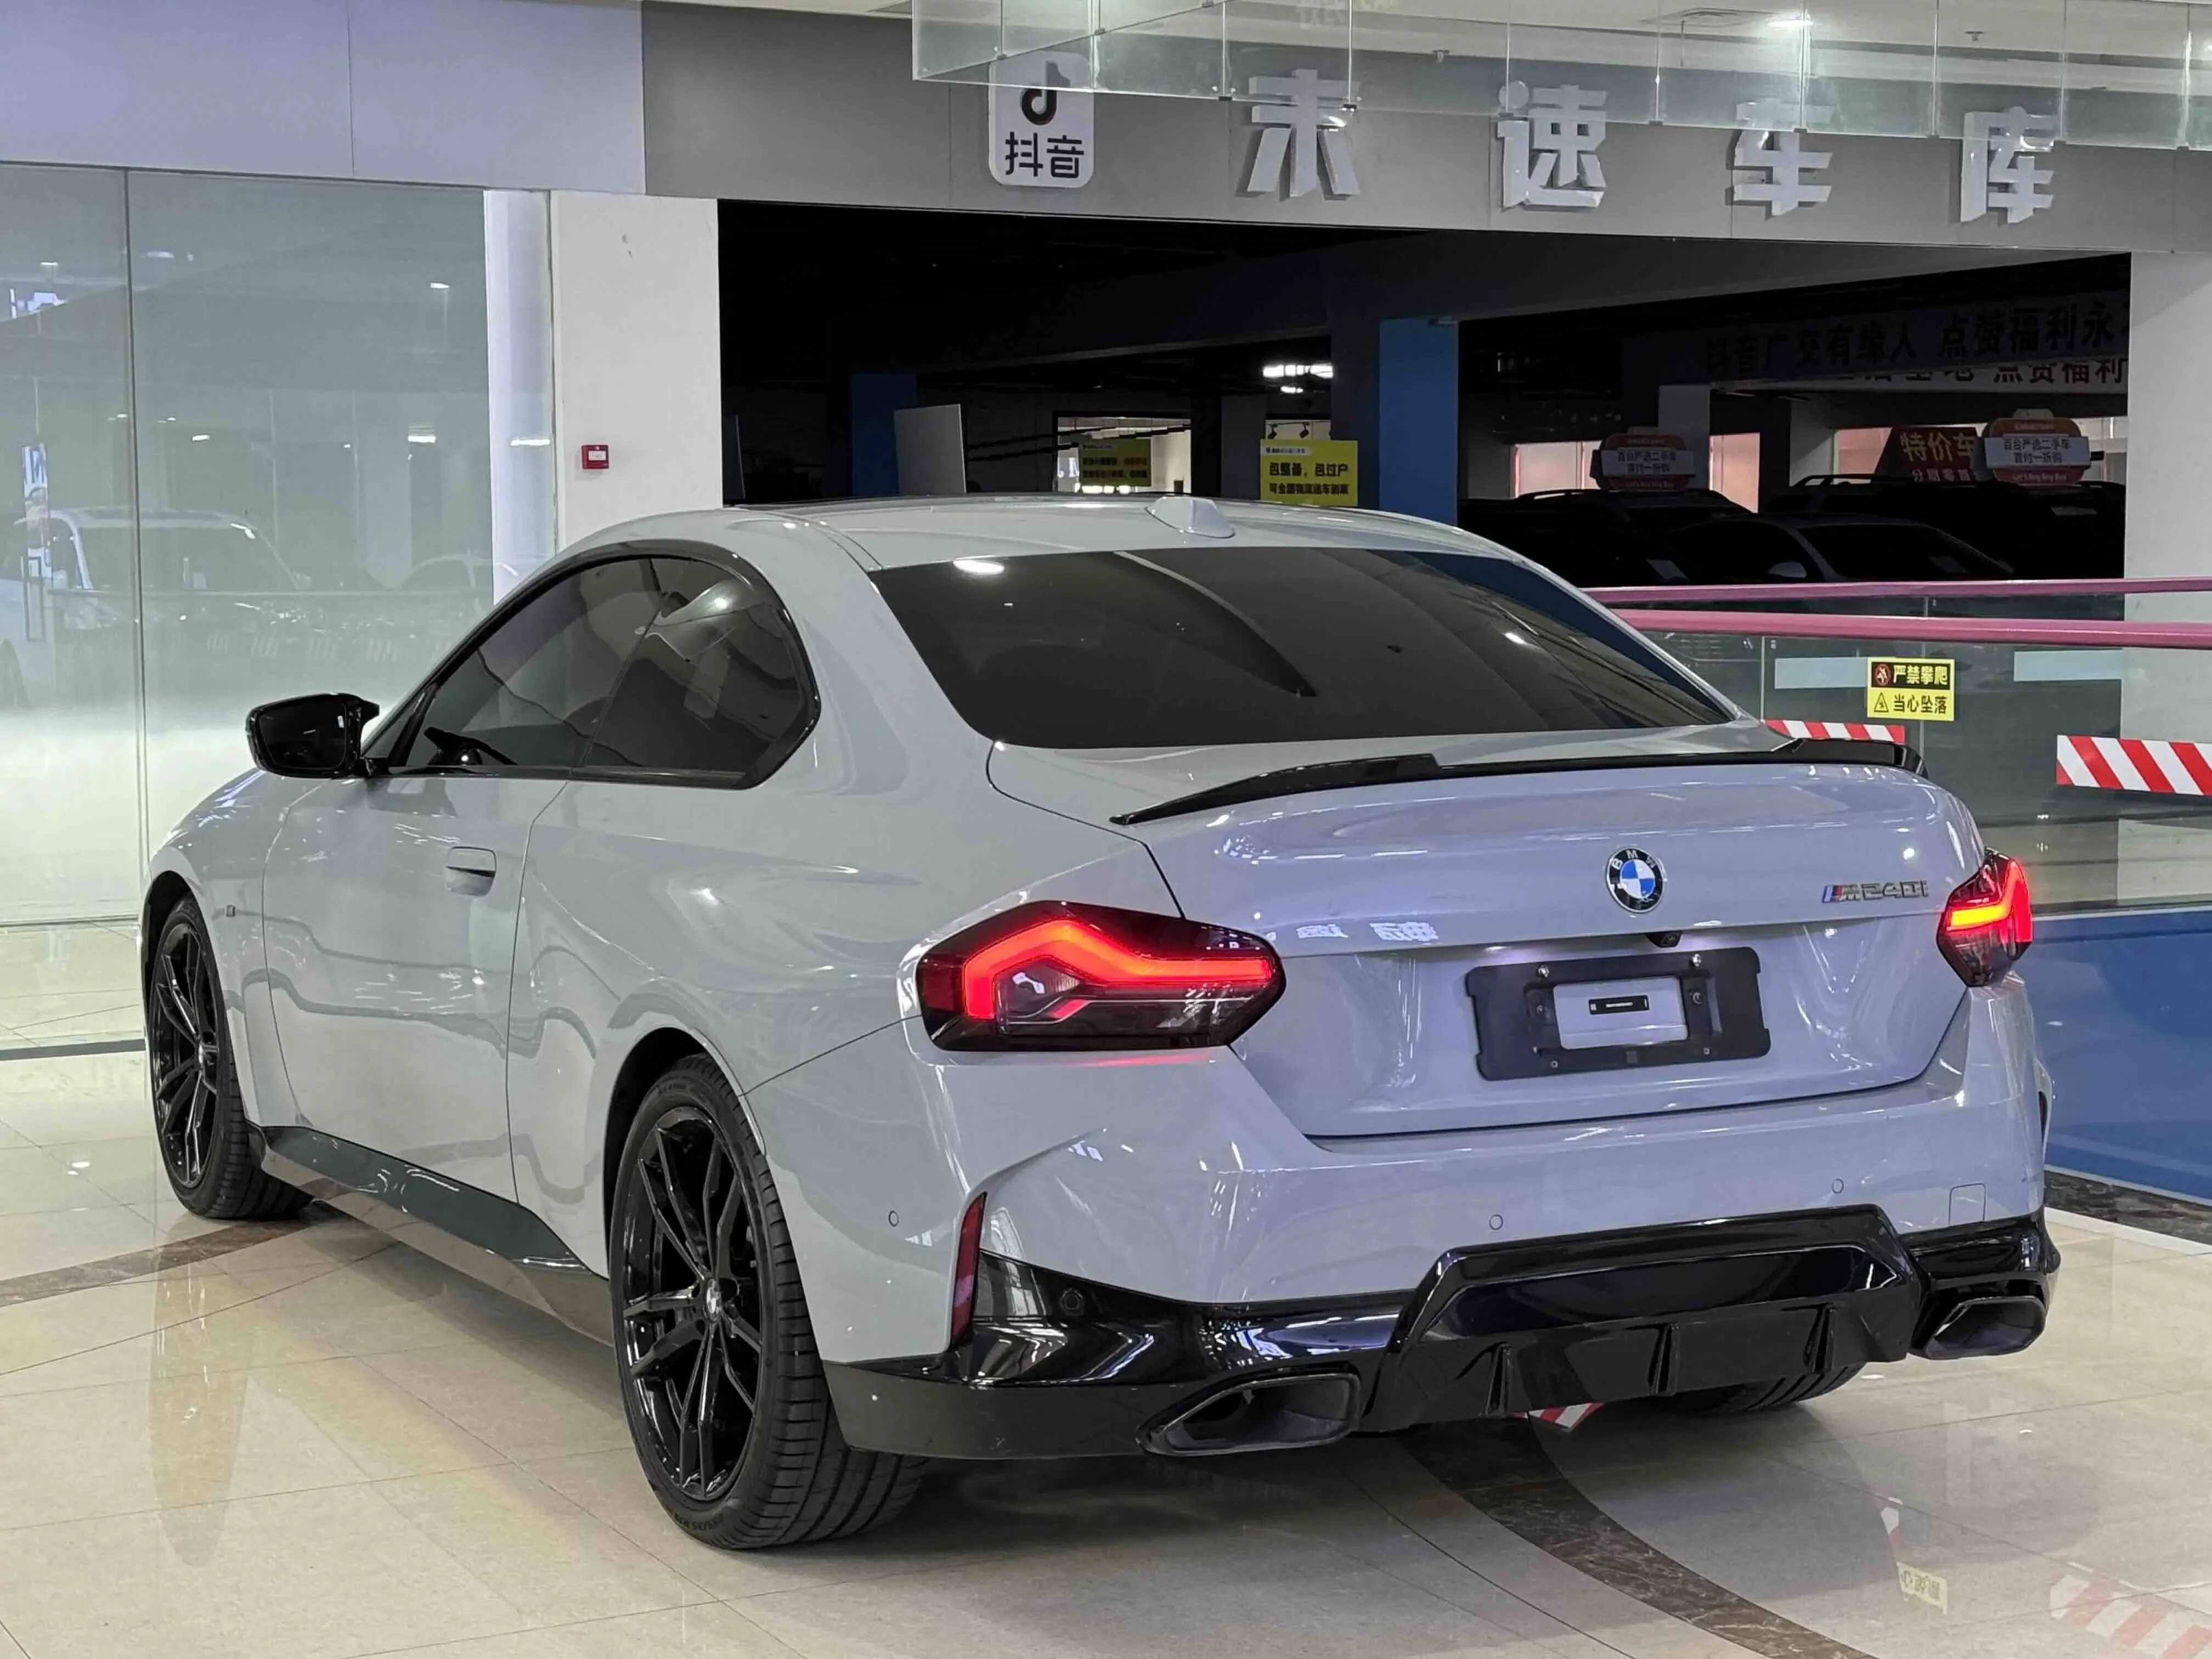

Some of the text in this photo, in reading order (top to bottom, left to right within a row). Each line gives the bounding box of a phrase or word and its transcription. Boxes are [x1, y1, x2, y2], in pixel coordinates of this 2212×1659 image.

[1005, 131, 1085, 179] 抖音
[1893, 665, 1948, 685] 严禁攀爬
[1893, 693, 1948, 714] 当心坠落
